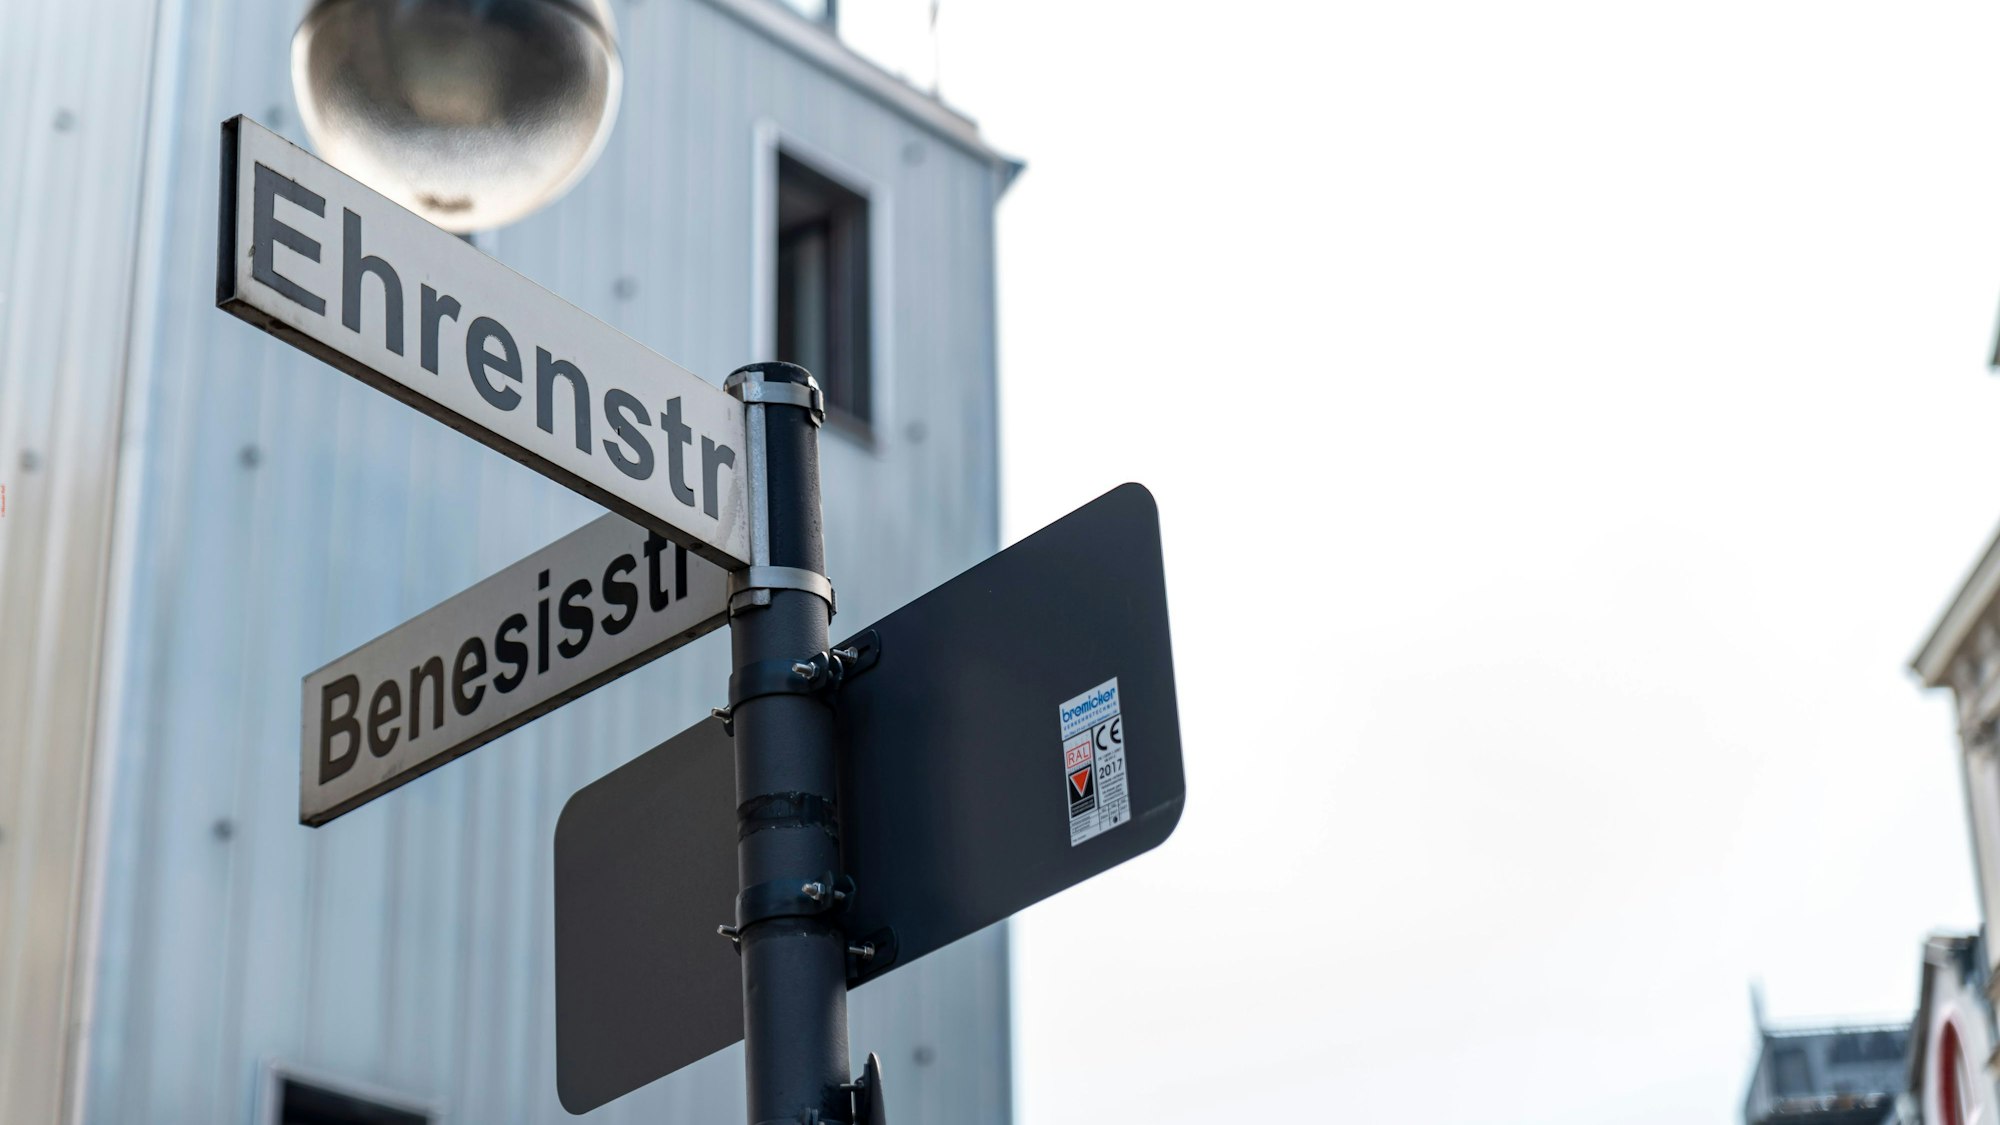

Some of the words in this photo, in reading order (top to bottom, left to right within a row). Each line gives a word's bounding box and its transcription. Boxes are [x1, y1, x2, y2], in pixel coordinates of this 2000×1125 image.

[253, 161, 735, 520] Ehrenstr
[1062, 688, 1116, 723] bremicker
[1068, 746, 1089, 766] RAL
[1099, 758, 1122, 779] 2017
